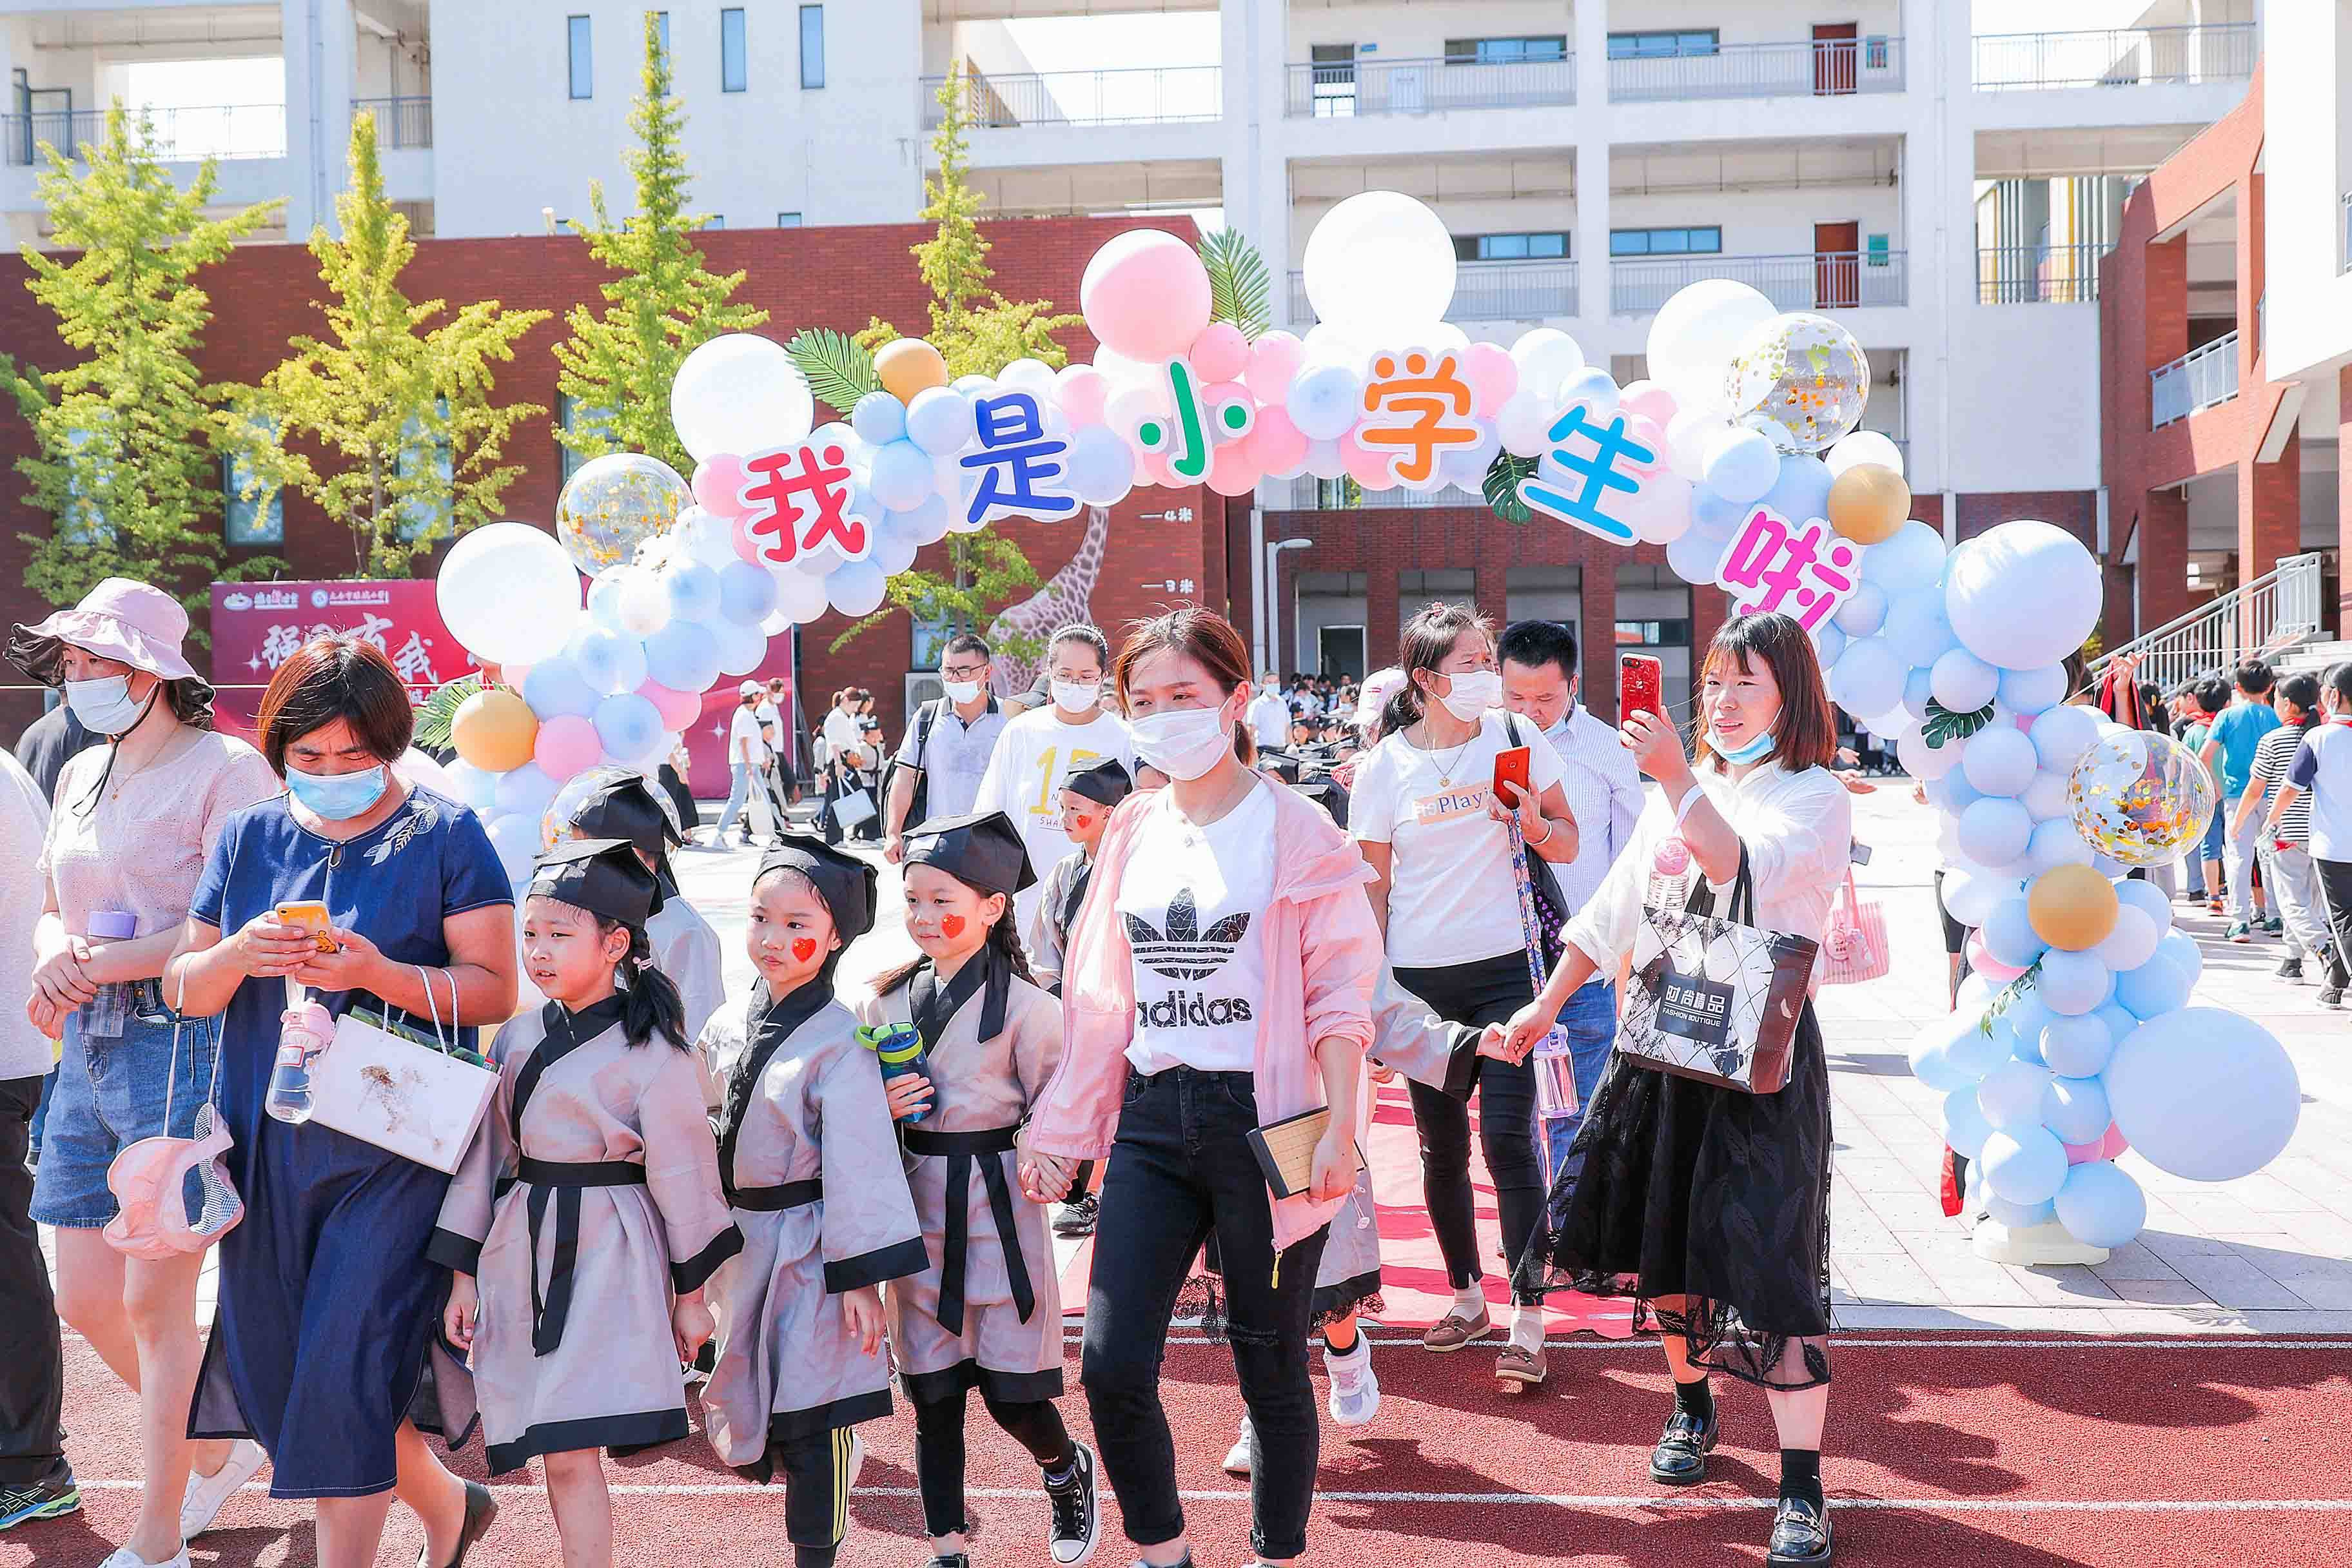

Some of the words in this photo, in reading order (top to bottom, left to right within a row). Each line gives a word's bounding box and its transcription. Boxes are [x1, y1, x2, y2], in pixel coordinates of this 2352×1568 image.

[745, 354, 1852, 632] 我是小学生啦
[1164, 507, 1193, 522] 4米
[1165, 578, 1193, 594] 3米
[1665, 985, 1725, 1014] 时尚精品
[1663, 1007, 1688, 1020] FASHION
[1688, 1014, 1721, 1027] BOUTIQUE
